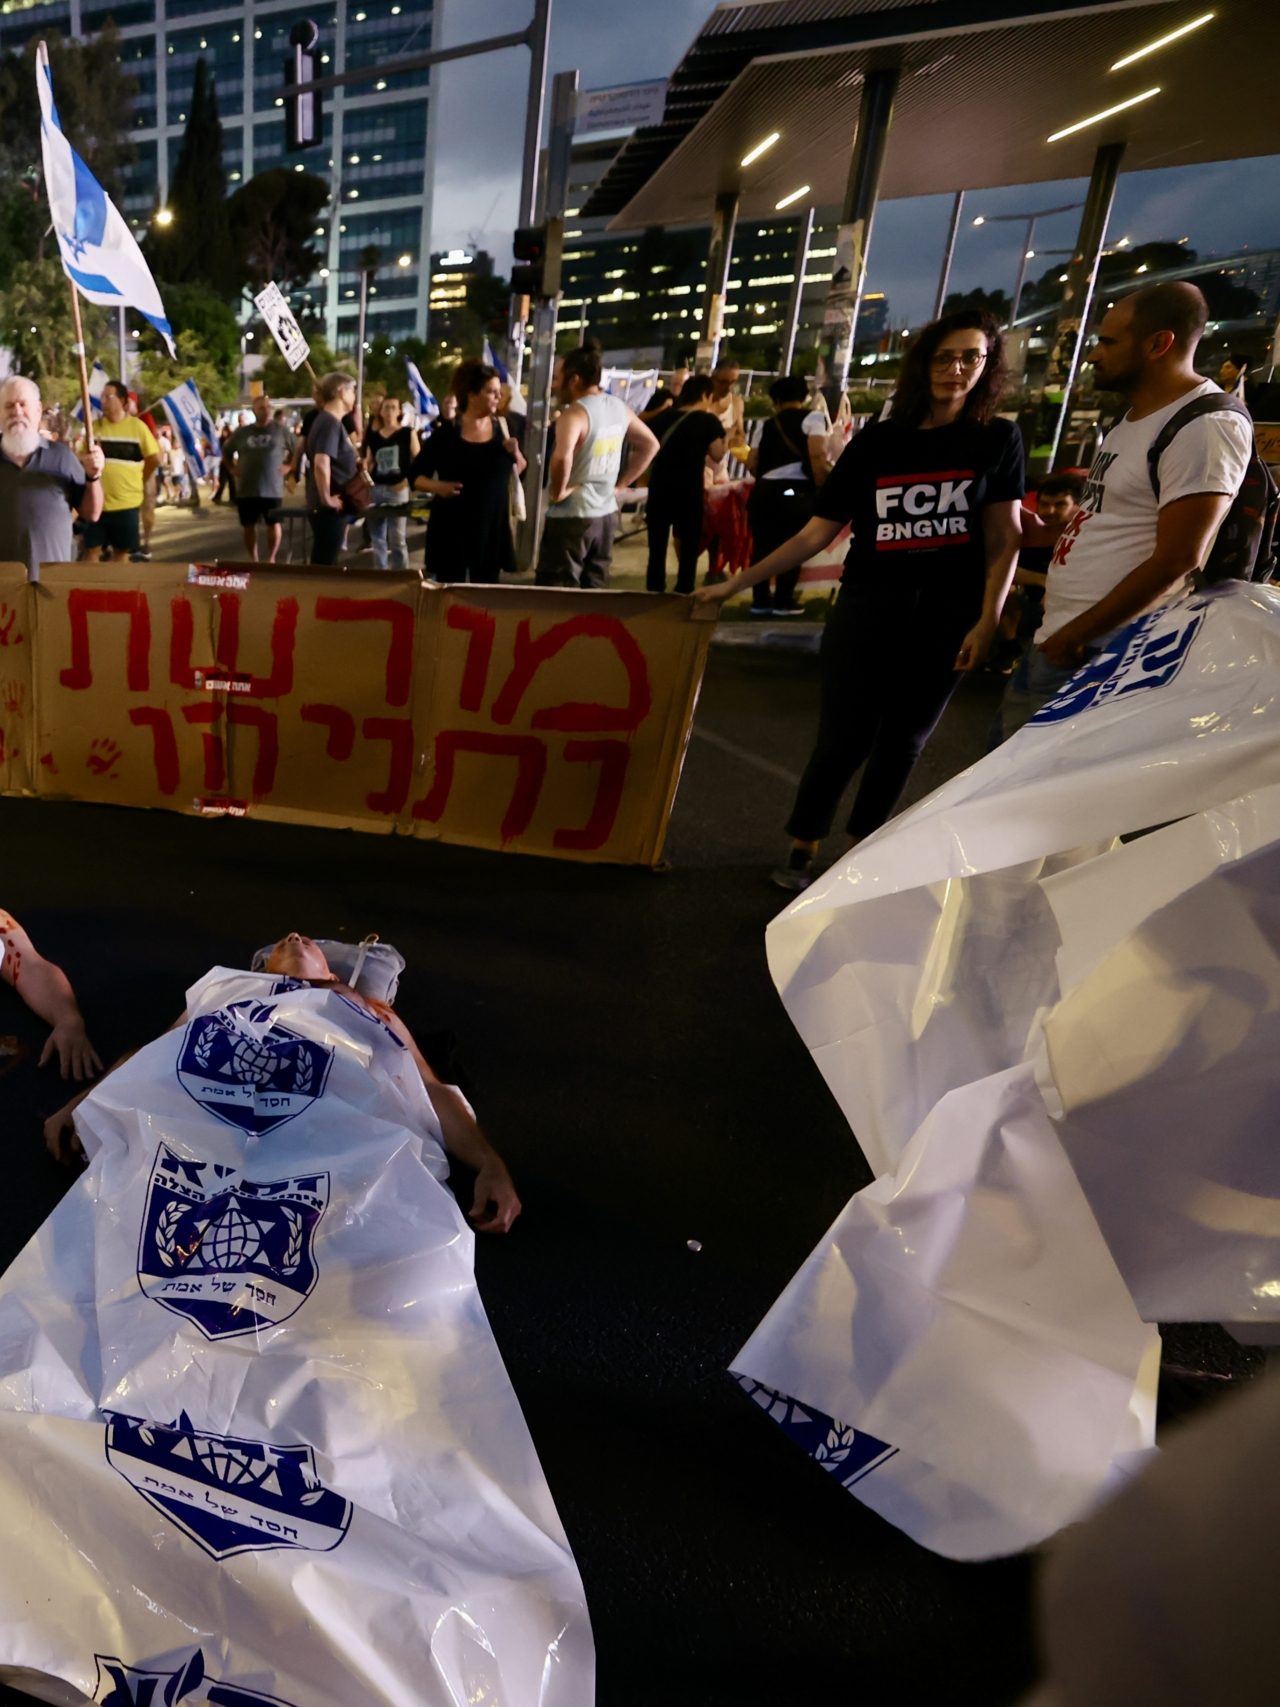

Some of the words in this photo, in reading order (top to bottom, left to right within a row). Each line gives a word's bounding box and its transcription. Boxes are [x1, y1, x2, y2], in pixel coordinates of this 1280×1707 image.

[876, 479, 973, 519] FCK
[876, 516, 968, 542] BNGVR
[60, 588, 652, 734] מורשת
[128, 701, 631, 850] נתניהו
[201, 1087, 236, 1097] אמת
[260, 1097, 291, 1108] חסד
[154, 1172, 206, 1201] הצלה
[162, 1283, 202, 1293] אמת
[211, 1277, 236, 1294] של
[245, 1282, 277, 1306] חסד
[143, 1475, 194, 1500] אמת
[205, 1491, 239, 1516] של
[250, 1515, 298, 1540] חסד
